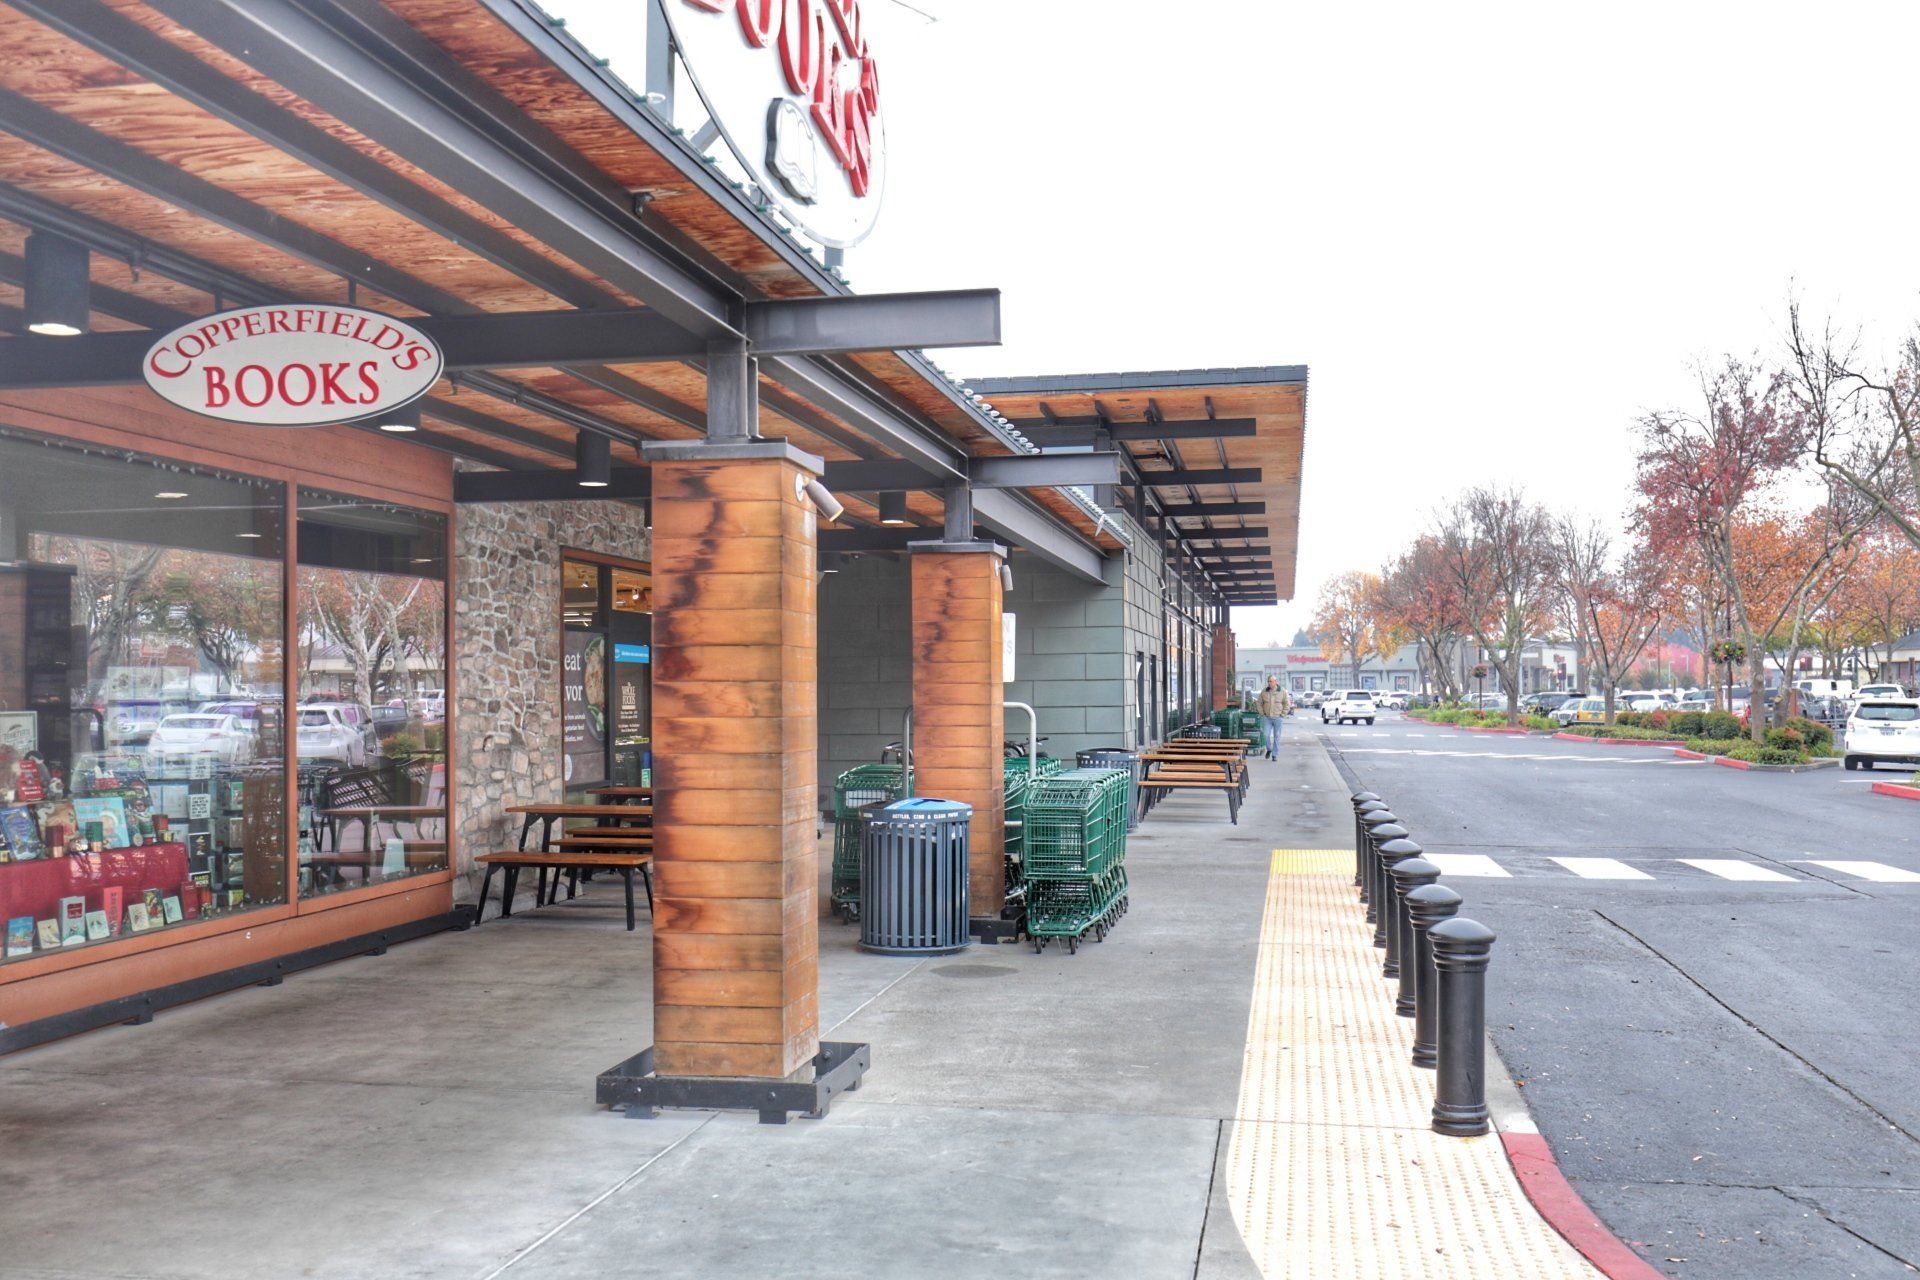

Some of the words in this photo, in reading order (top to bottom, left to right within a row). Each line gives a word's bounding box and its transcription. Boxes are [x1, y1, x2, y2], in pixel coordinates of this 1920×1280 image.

[150, 309, 432, 379] COPPERFIELD'S
[203, 361, 380, 408] BOOKS
[564, 685, 583, 701] vor
